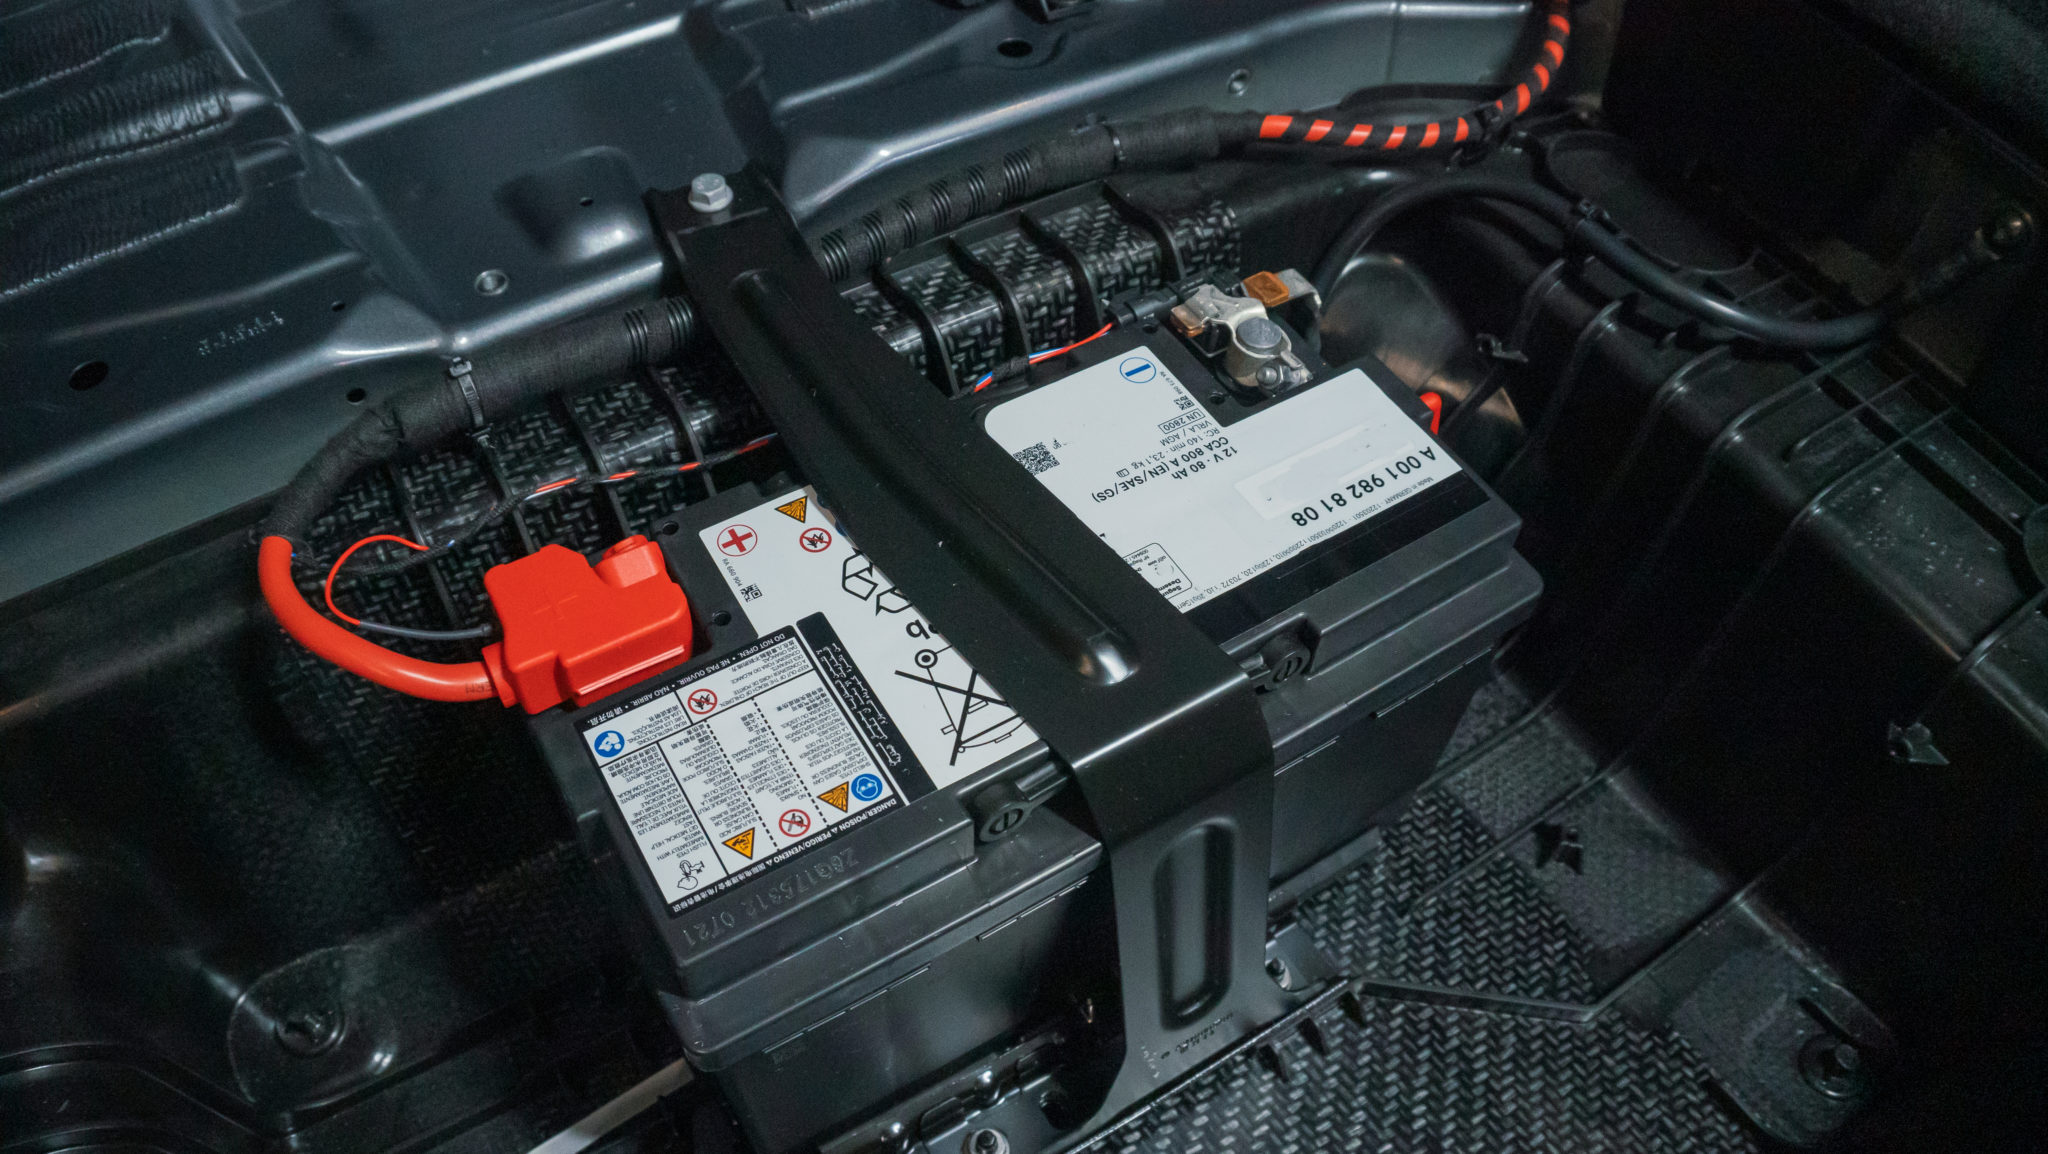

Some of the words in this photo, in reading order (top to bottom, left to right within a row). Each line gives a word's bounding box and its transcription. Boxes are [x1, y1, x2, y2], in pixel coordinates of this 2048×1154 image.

[1185, 410, 1201, 421] UN
[1162, 417, 1186, 431] 2800
[1187, 419, 1212, 433] VRLA
[1202, 426, 1220, 437] RC:
[1159, 432, 1182, 446] AGM
[1185, 434, 1203, 445] 140
[1202, 435, 1229, 451] CCA
[1168, 442, 1187, 453] min
[1179, 447, 1205, 462] 800
[1221, 445, 1237, 456] 12
[1418, 446, 1437, 462] A
[1143, 450, 1165, 464] 23,1
[1168, 458, 1181, 467] A
[1210, 452, 1223, 462] V
[1130, 459, 1145, 470] kg
[1187, 460, 1206, 472] 80
[1384, 454, 1423, 480] 001
[1170, 468, 1190, 480] Ah
[1088, 461, 1171, 503] (EN/SAE/GS)
[1344, 472, 1386, 500] 982
[1319, 491, 1349, 513] 81
[1382, 487, 1413, 504] GERMANY
[1289, 505, 1321, 527] 08
[758, 638, 774, 648] NOT
[773, 632, 785, 641] DO
[737, 644, 759, 658] OPEN.
[705, 663, 719, 673] PAS
[719, 658, 730, 667] NE
[676, 668, 705, 686] OUVRIR.
[653, 685, 670, 697] NÃO
[630, 692, 653, 707] ABRIR.
[837, 798, 897, 830] DANGER/POISON
[772, 830, 832, 863] PERIGO/VENENO
